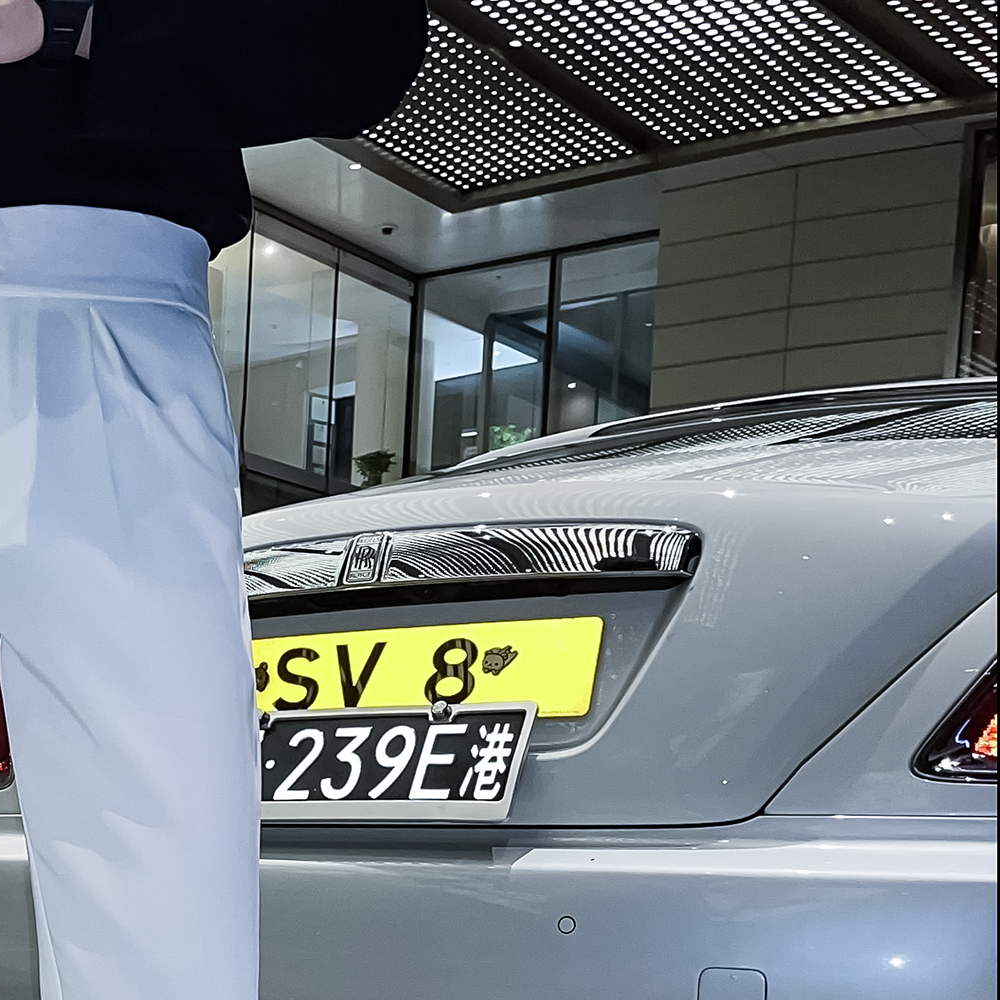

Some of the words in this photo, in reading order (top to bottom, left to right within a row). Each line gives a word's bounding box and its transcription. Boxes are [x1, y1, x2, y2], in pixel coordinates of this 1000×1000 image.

[272, 641, 388, 711] SV
[424, 637, 478, 705] 8
[259, 723, 515, 801] ·239E港
